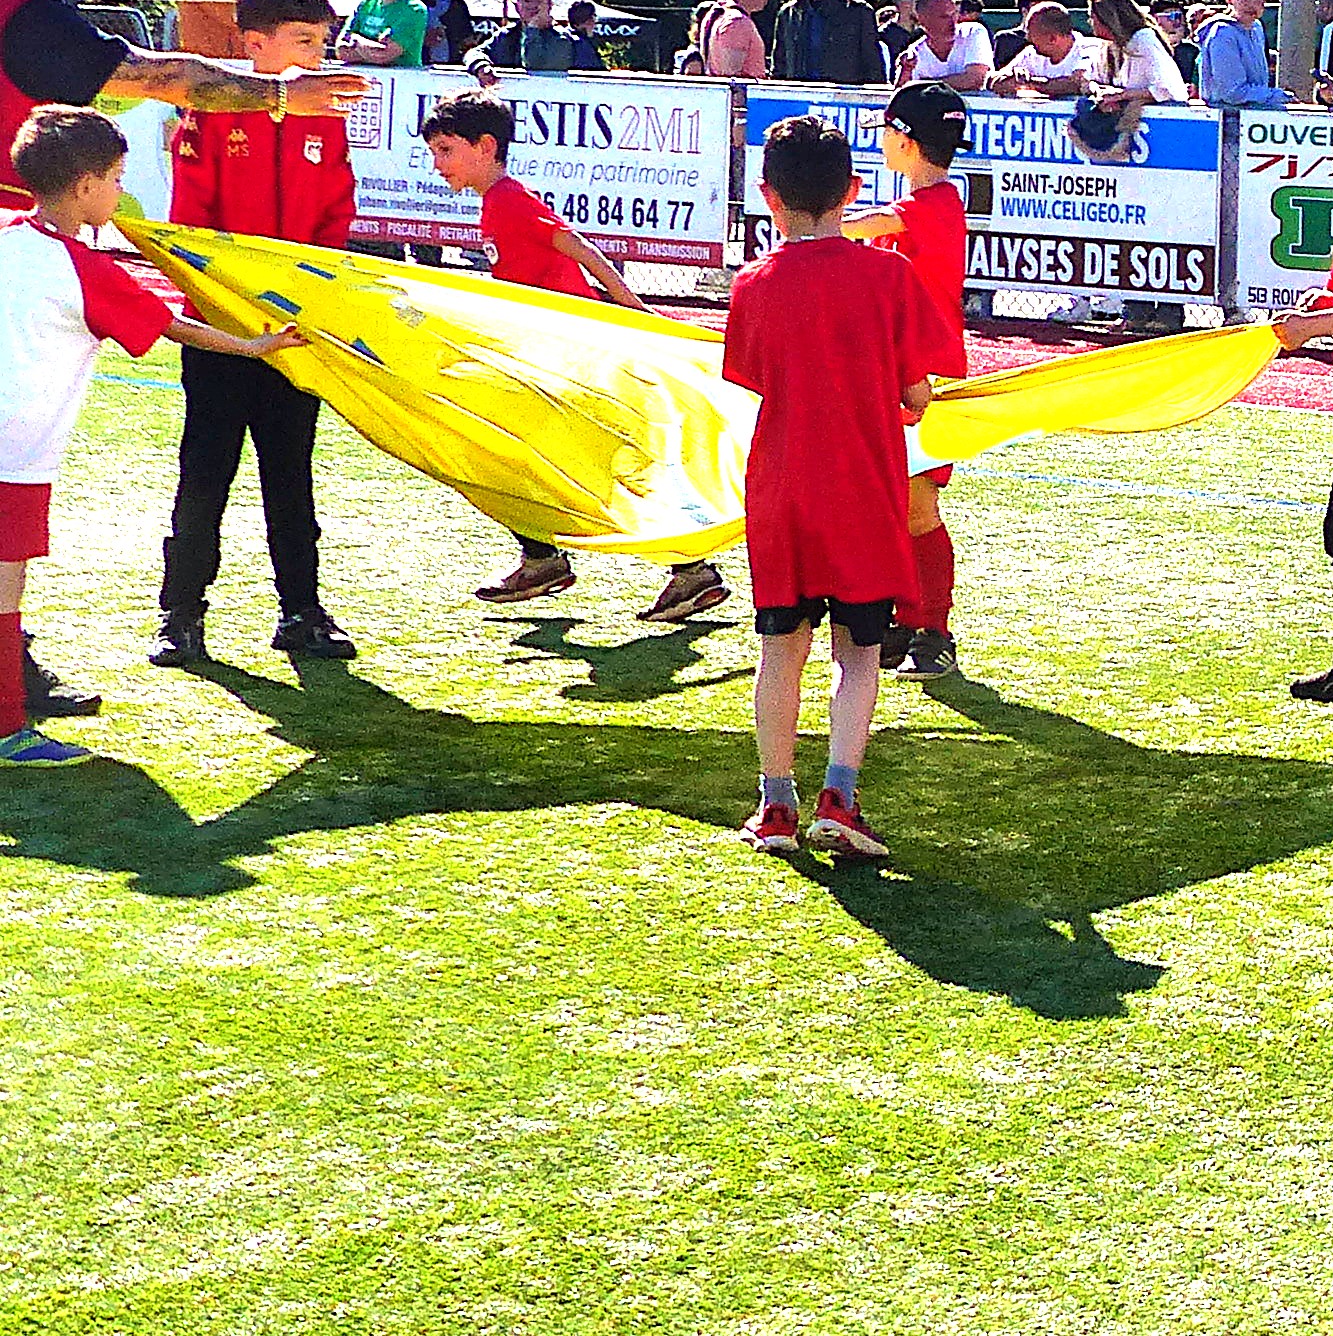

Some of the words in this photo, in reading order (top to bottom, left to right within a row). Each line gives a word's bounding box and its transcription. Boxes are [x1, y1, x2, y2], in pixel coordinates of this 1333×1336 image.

[542, 161, 585, 180] mon
[589, 161, 700, 188] patrimoine
[1001, 171, 1118, 199] SAINT-JOSEPH
[562, 192, 590, 224] 48
[597, 194, 625, 227] 84
[631, 197, 660, 230] 64
[667, 199, 696, 232] 77
[1001, 196, 1147, 226] WWW.CELIGEO.FR
[636, 239, 711, 261] TRANSMISSION
[965, 234, 1075, 284] ALYSES
[1083, 241, 1121, 286] DE
[1129, 245, 1205, 292] SOLS
[1271, 288, 1303, 307] ROU
